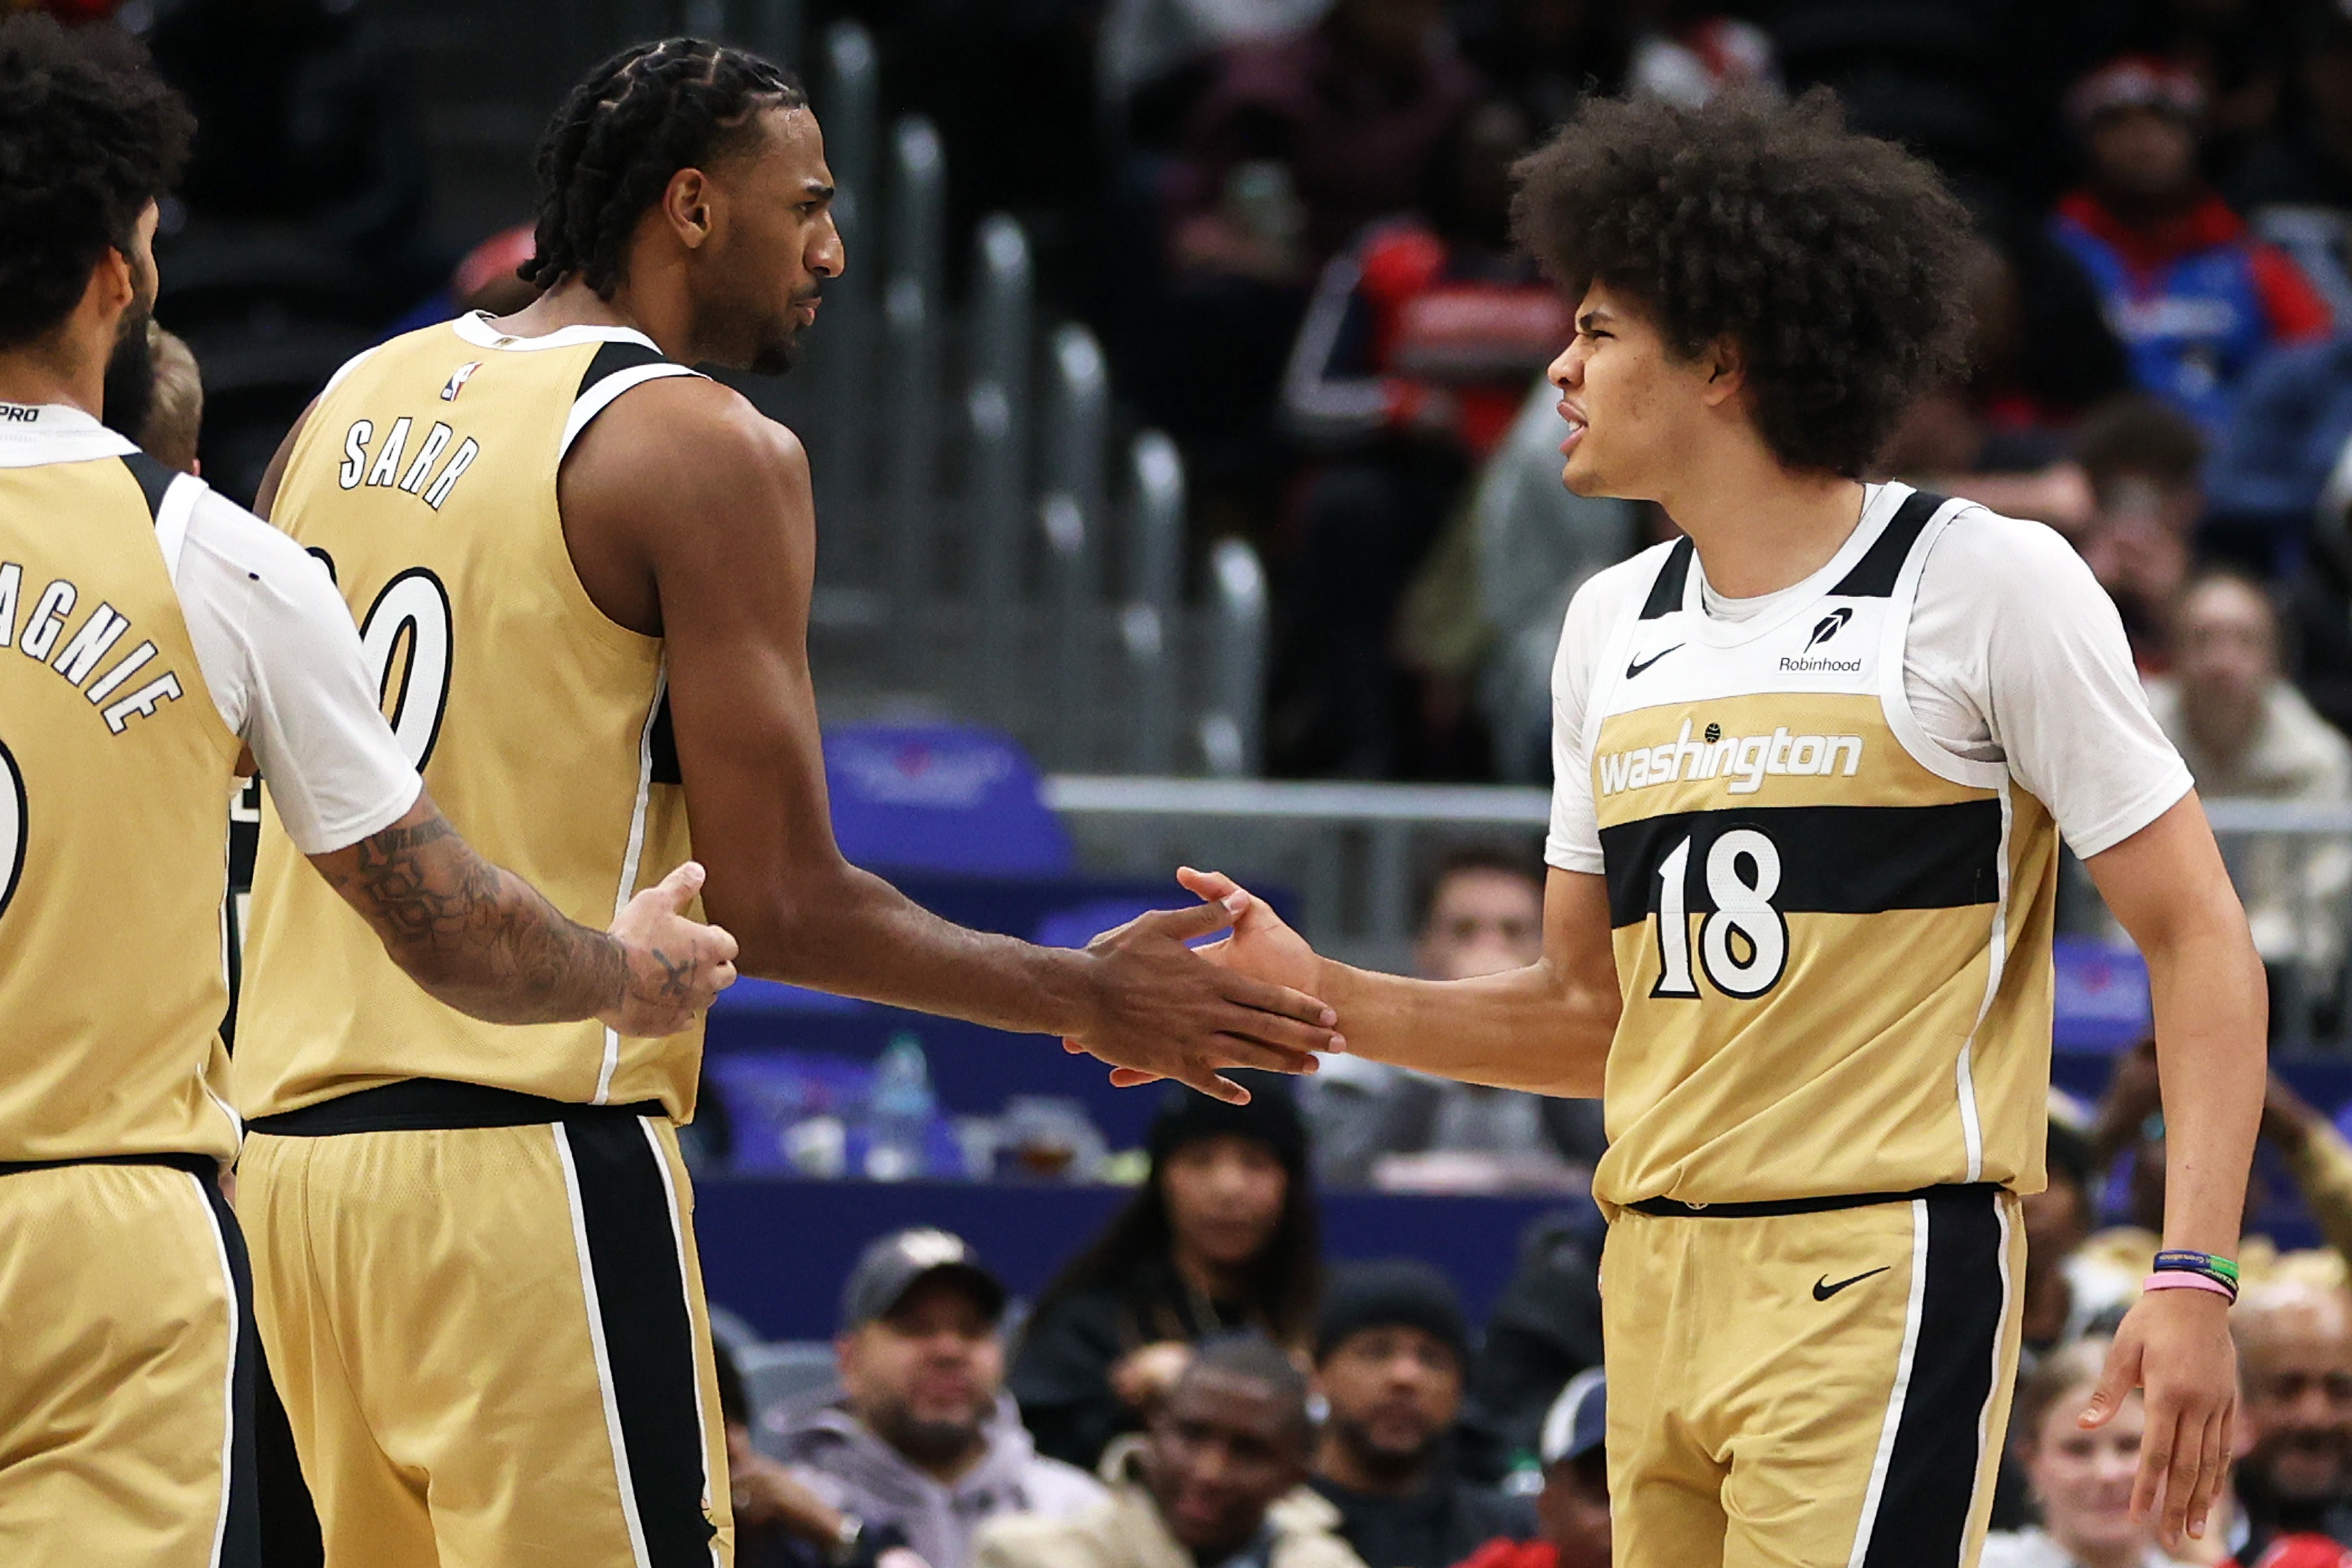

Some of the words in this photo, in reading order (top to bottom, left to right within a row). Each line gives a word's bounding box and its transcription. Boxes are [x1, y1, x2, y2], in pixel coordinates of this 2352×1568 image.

[0, 406, 39, 422] PRO
[338, 416, 480, 513] SARR
[1779, 657, 1861, 671] Robinhood
[1599, 717, 1863, 797] washington
[1649, 826, 1789, 1000] 18
